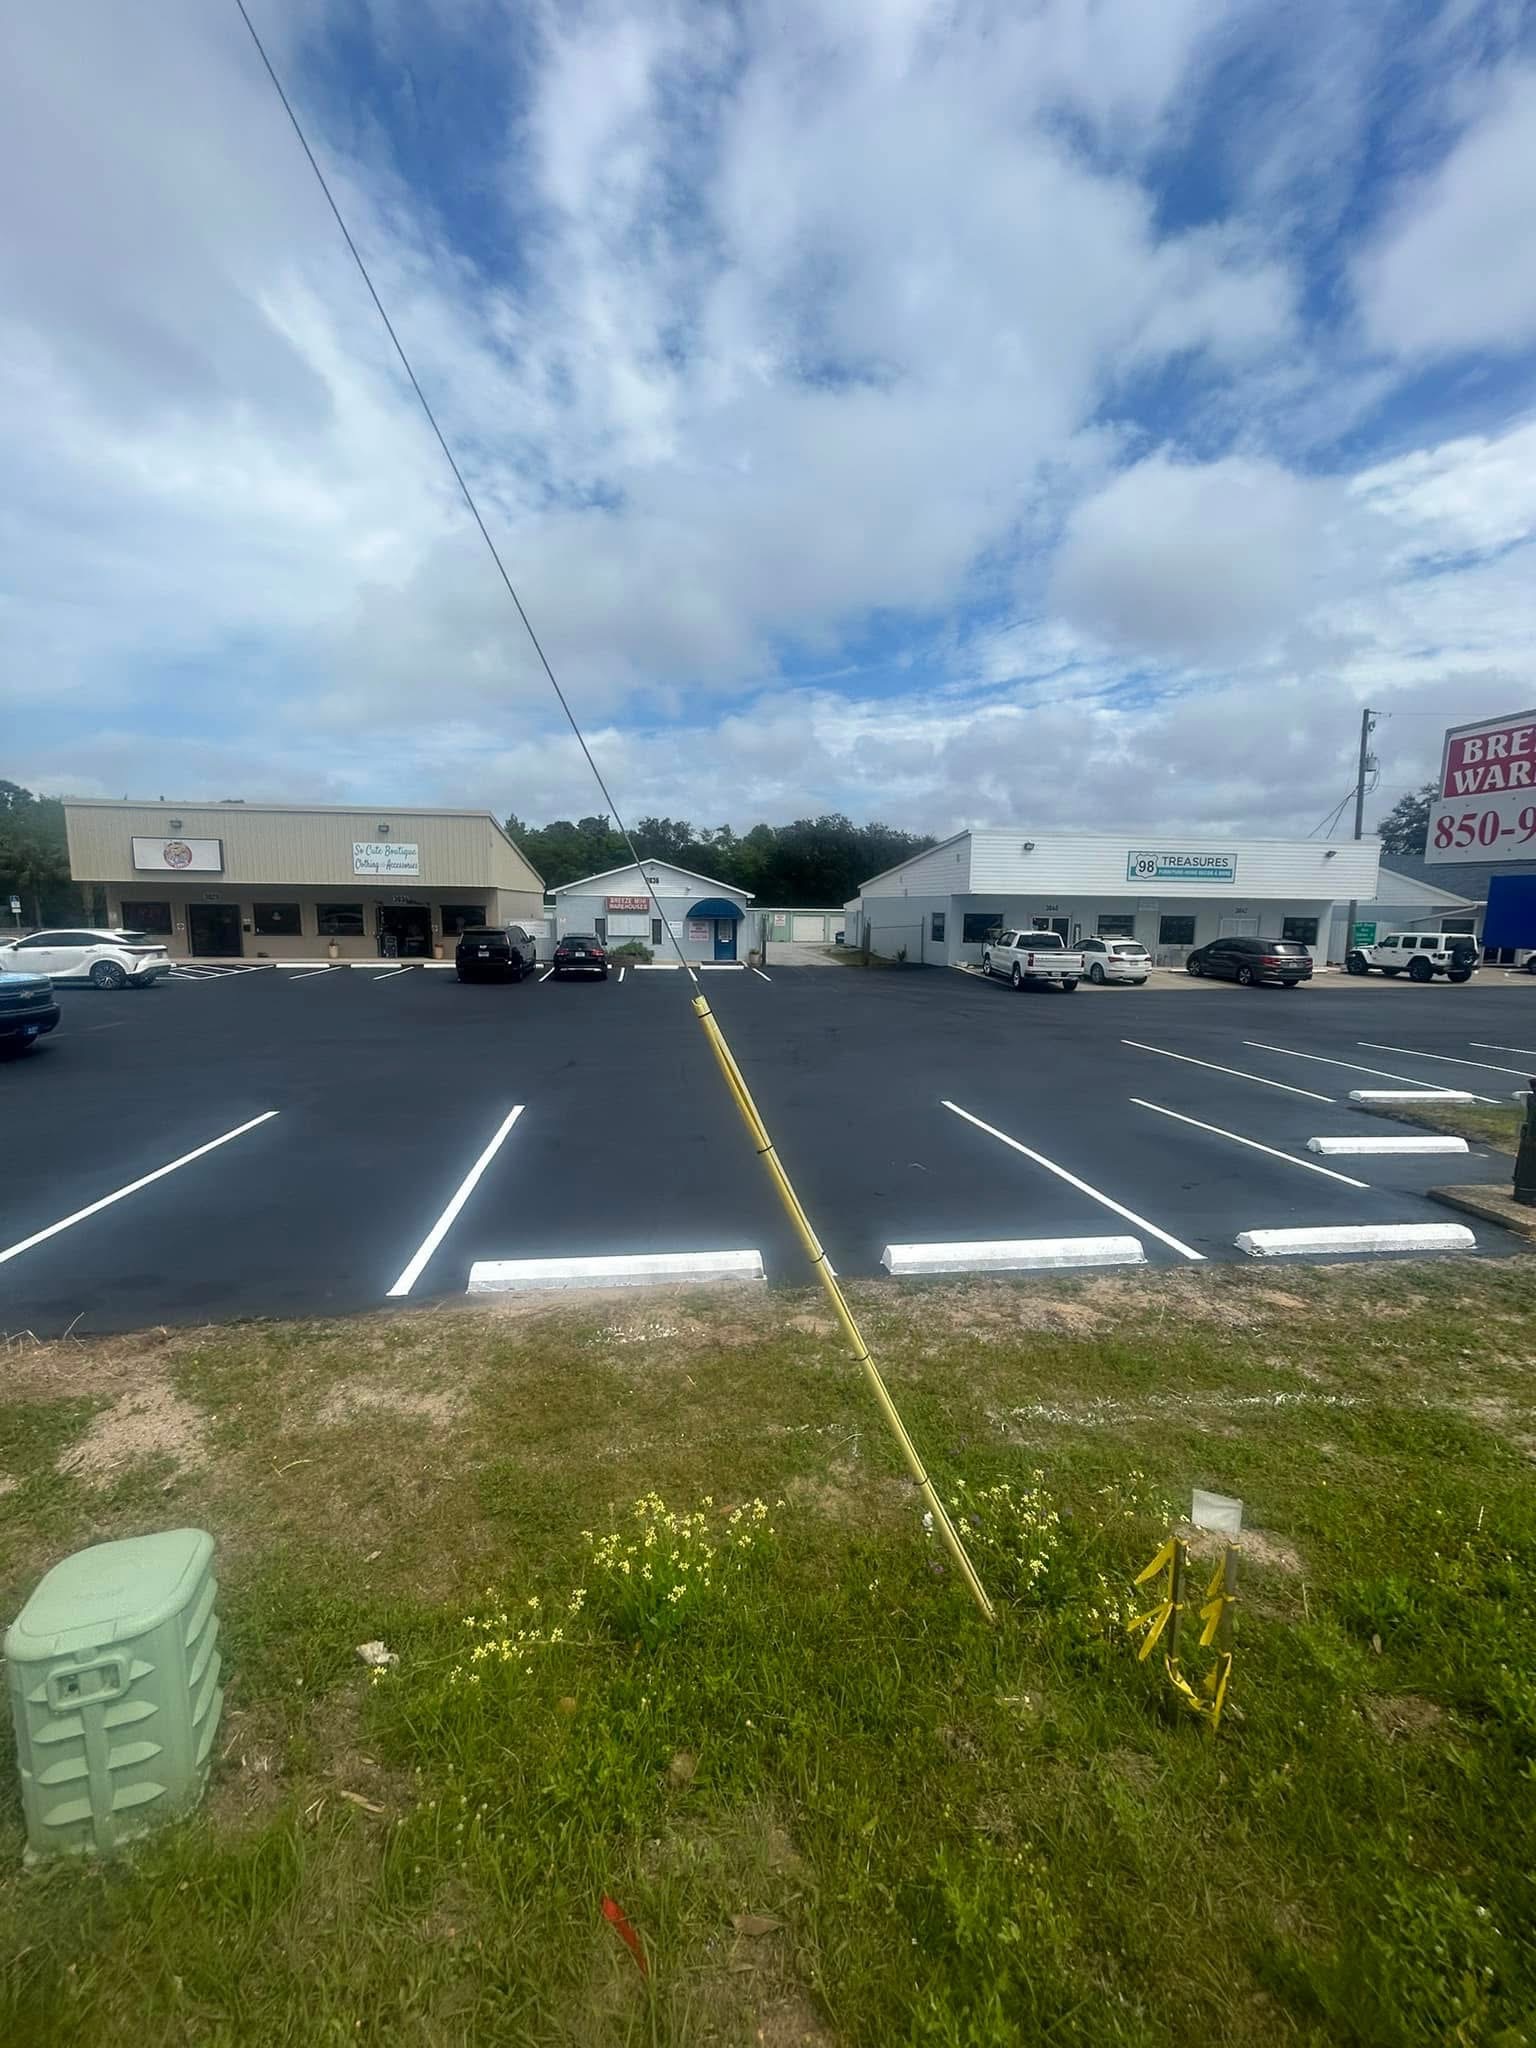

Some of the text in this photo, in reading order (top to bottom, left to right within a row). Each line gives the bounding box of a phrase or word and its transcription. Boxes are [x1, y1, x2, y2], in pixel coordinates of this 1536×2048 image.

[1462, 728, 1536, 765] BRE
[1453, 760, 1536, 794] WAR
[355, 844, 416, 860] So Cute Boutique
[355, 858, 379, 873] Clothing
[386, 859, 418, 870] Accessories
[1139, 860, 1154, 873] 98
[1162, 856, 1229, 867] TREASURES
